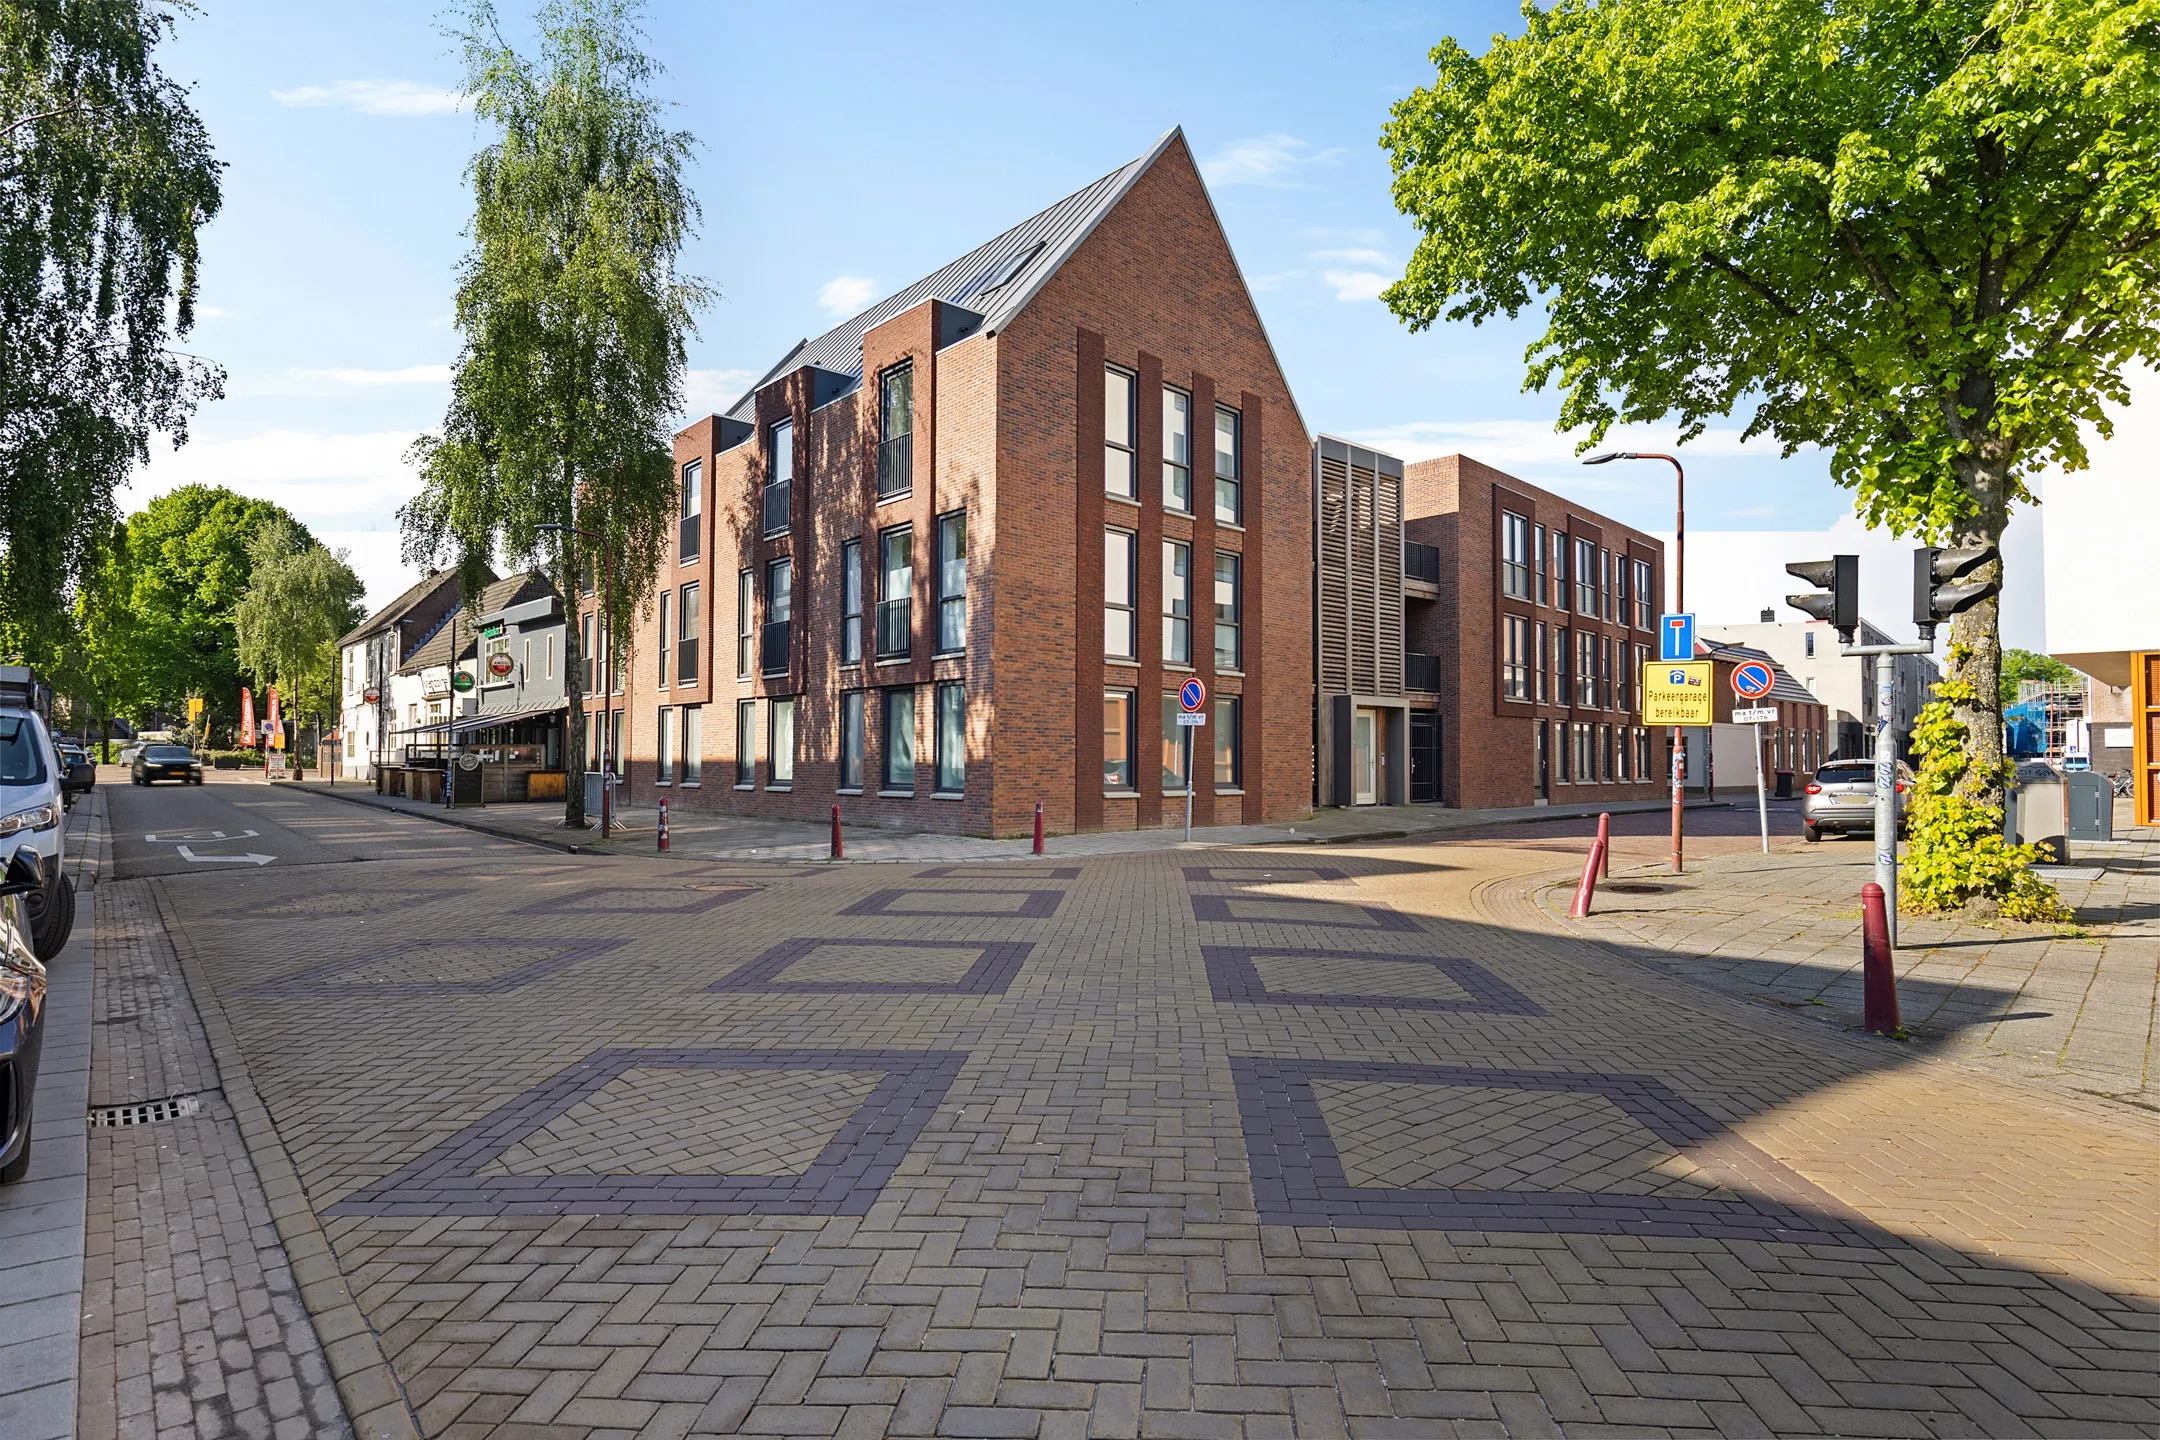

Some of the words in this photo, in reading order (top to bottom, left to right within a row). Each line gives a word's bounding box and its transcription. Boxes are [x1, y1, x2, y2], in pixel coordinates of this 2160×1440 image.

[1673, 674, 1682, 684] P
[1648, 690, 1707, 705] Parkeergarage
[1655, 707, 1699, 719] bereikbaar
[1748, 708, 1764, 716] t/m
